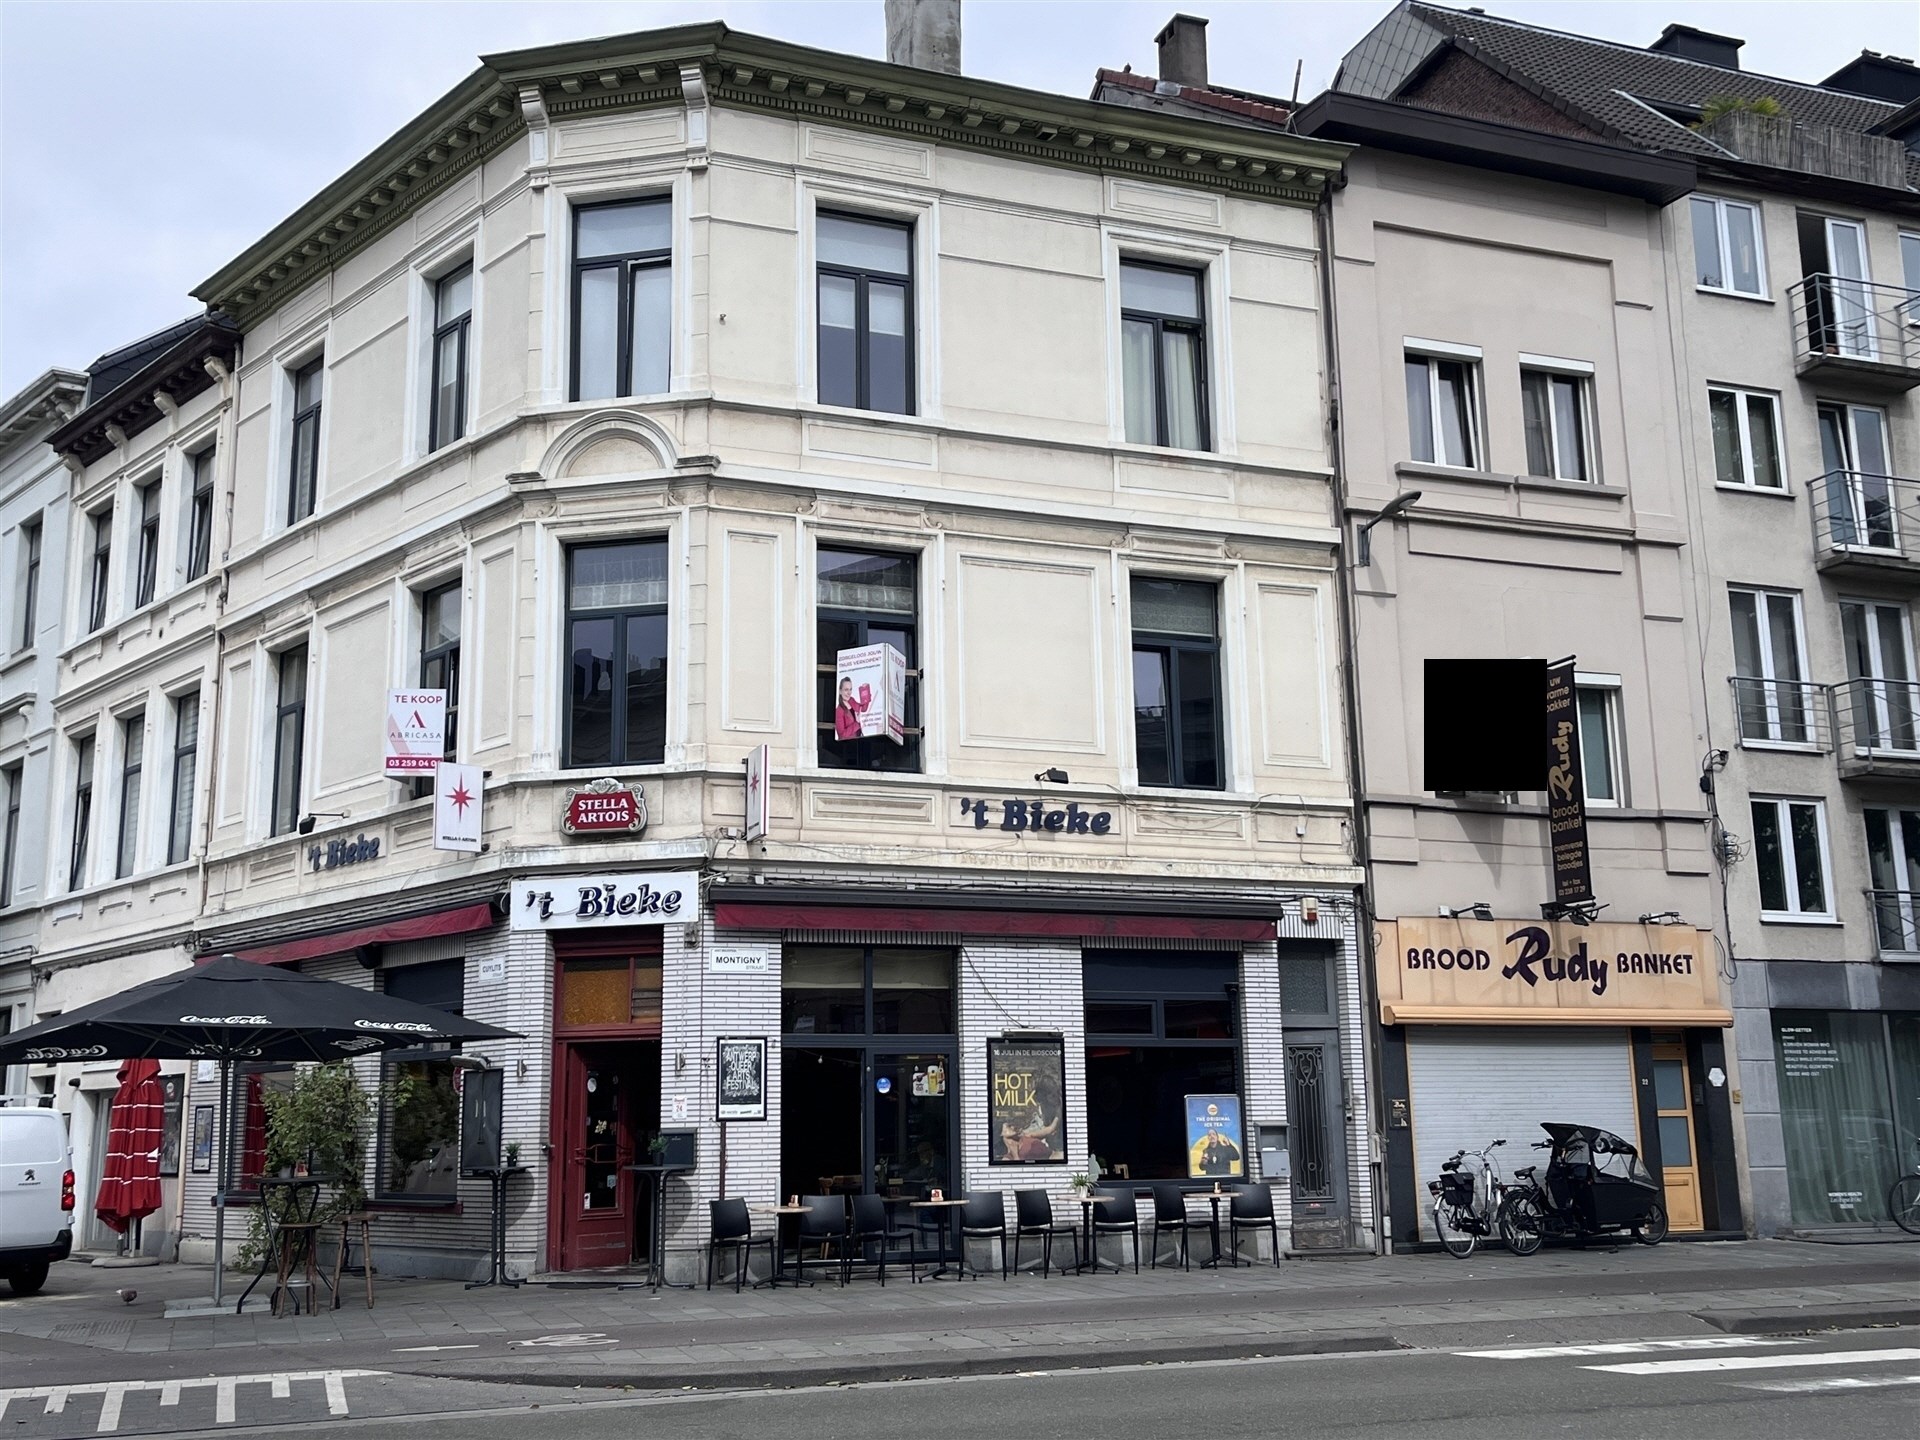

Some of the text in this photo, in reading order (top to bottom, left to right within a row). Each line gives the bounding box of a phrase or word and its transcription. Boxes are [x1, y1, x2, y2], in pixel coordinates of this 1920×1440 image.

[1549, 677, 1561, 687] uw
[394, 695, 443, 704] TE KOOP
[1548, 721, 1574, 801] Rudy
[578, 798, 629, 811] STELLA
[1552, 802, 1579, 818] brood
[577, 810, 630, 823] ARTOIS
[1000, 799, 1112, 835] Bieke
[1551, 815, 1583, 832] banket
[325, 833, 380, 870] Bieke
[1557, 859, 1584, 871] broodjes
[575, 883, 683, 917] Bieke
[715, 956, 762, 964] MONTIGNY
[1407, 926, 1693, 996] BROOD Rudy BANKET
[726, 1052, 757, 1062] ANTWERP
[730, 1061, 752, 1071] QUEER
[732, 1071, 751, 1081] ARTS
[994, 1073, 1033, 1090] HOT
[726, 1080, 756, 1090] FESTIVAL
[995, 1090, 1038, 1107] MILK
